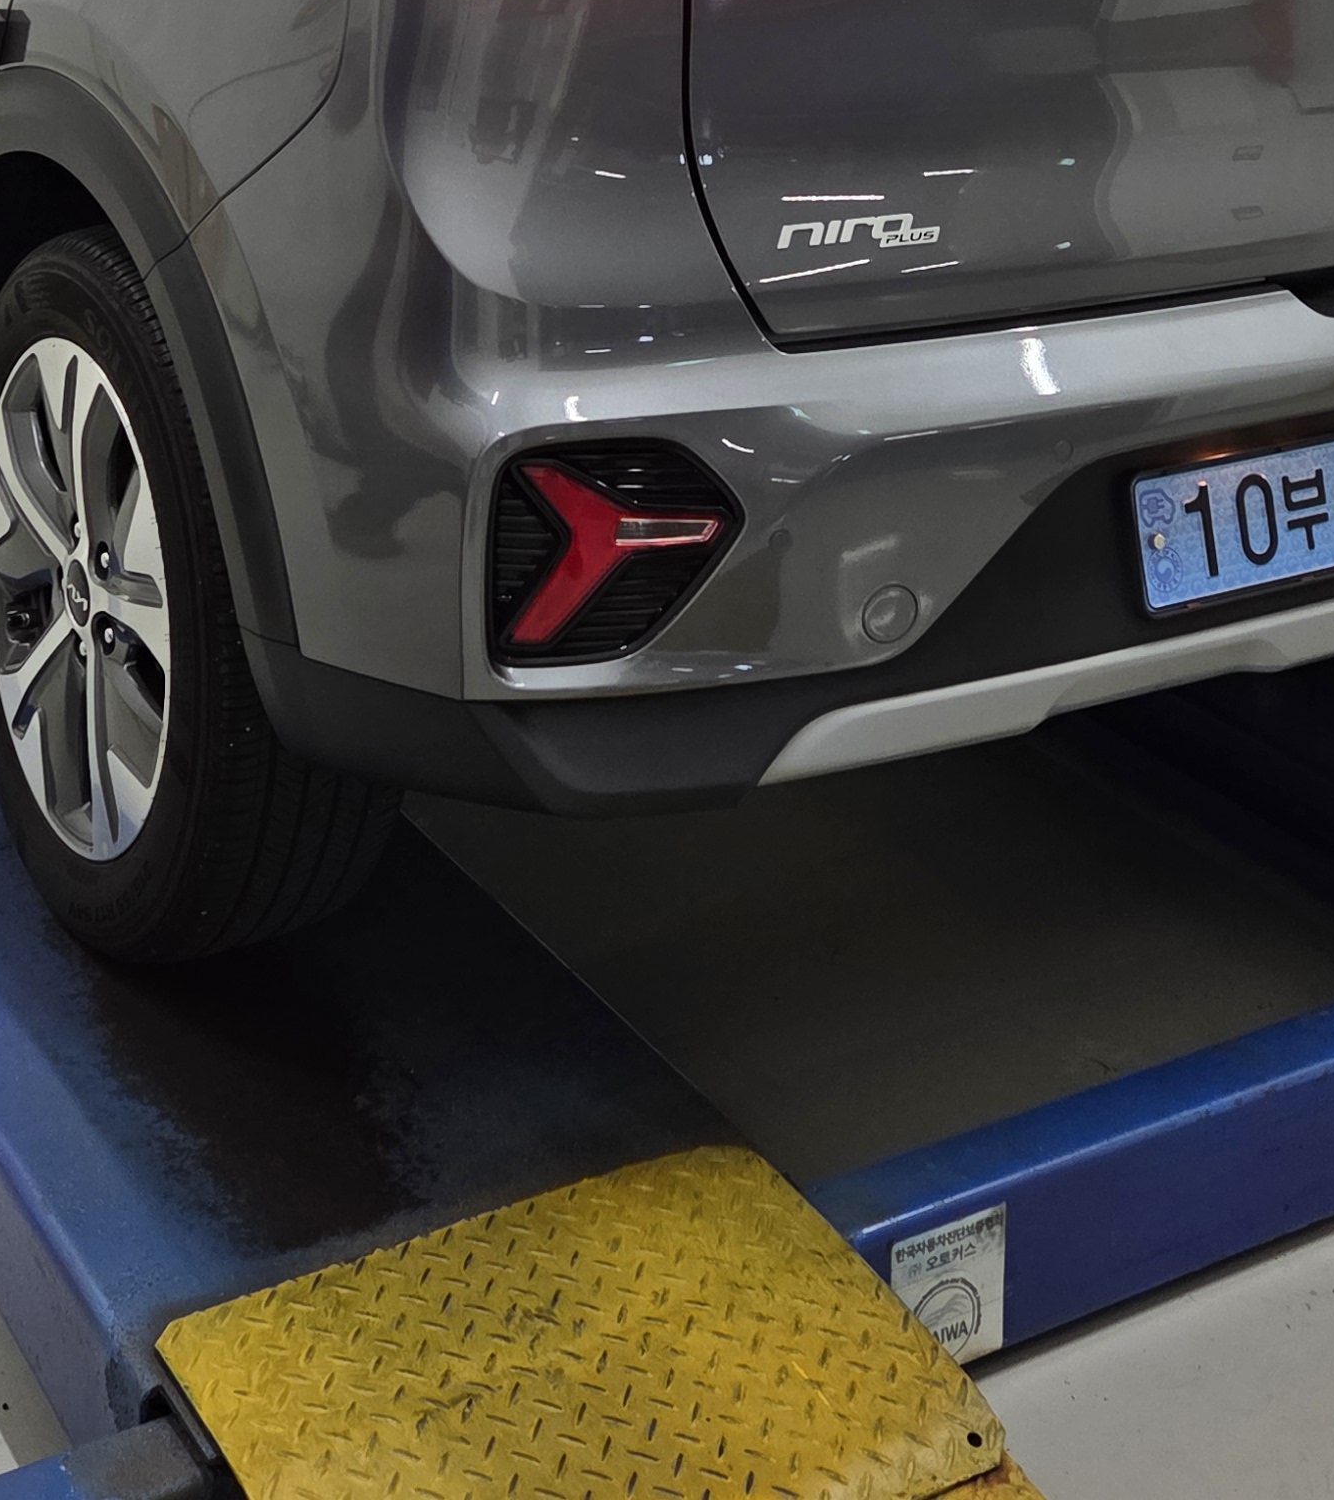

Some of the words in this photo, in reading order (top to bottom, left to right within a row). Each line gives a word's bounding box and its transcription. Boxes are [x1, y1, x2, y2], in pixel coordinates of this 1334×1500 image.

[884, 229, 936, 245] PLUS
[1183, 468, 1330, 578] 10부
[932, 1319, 970, 1345] AIWA
